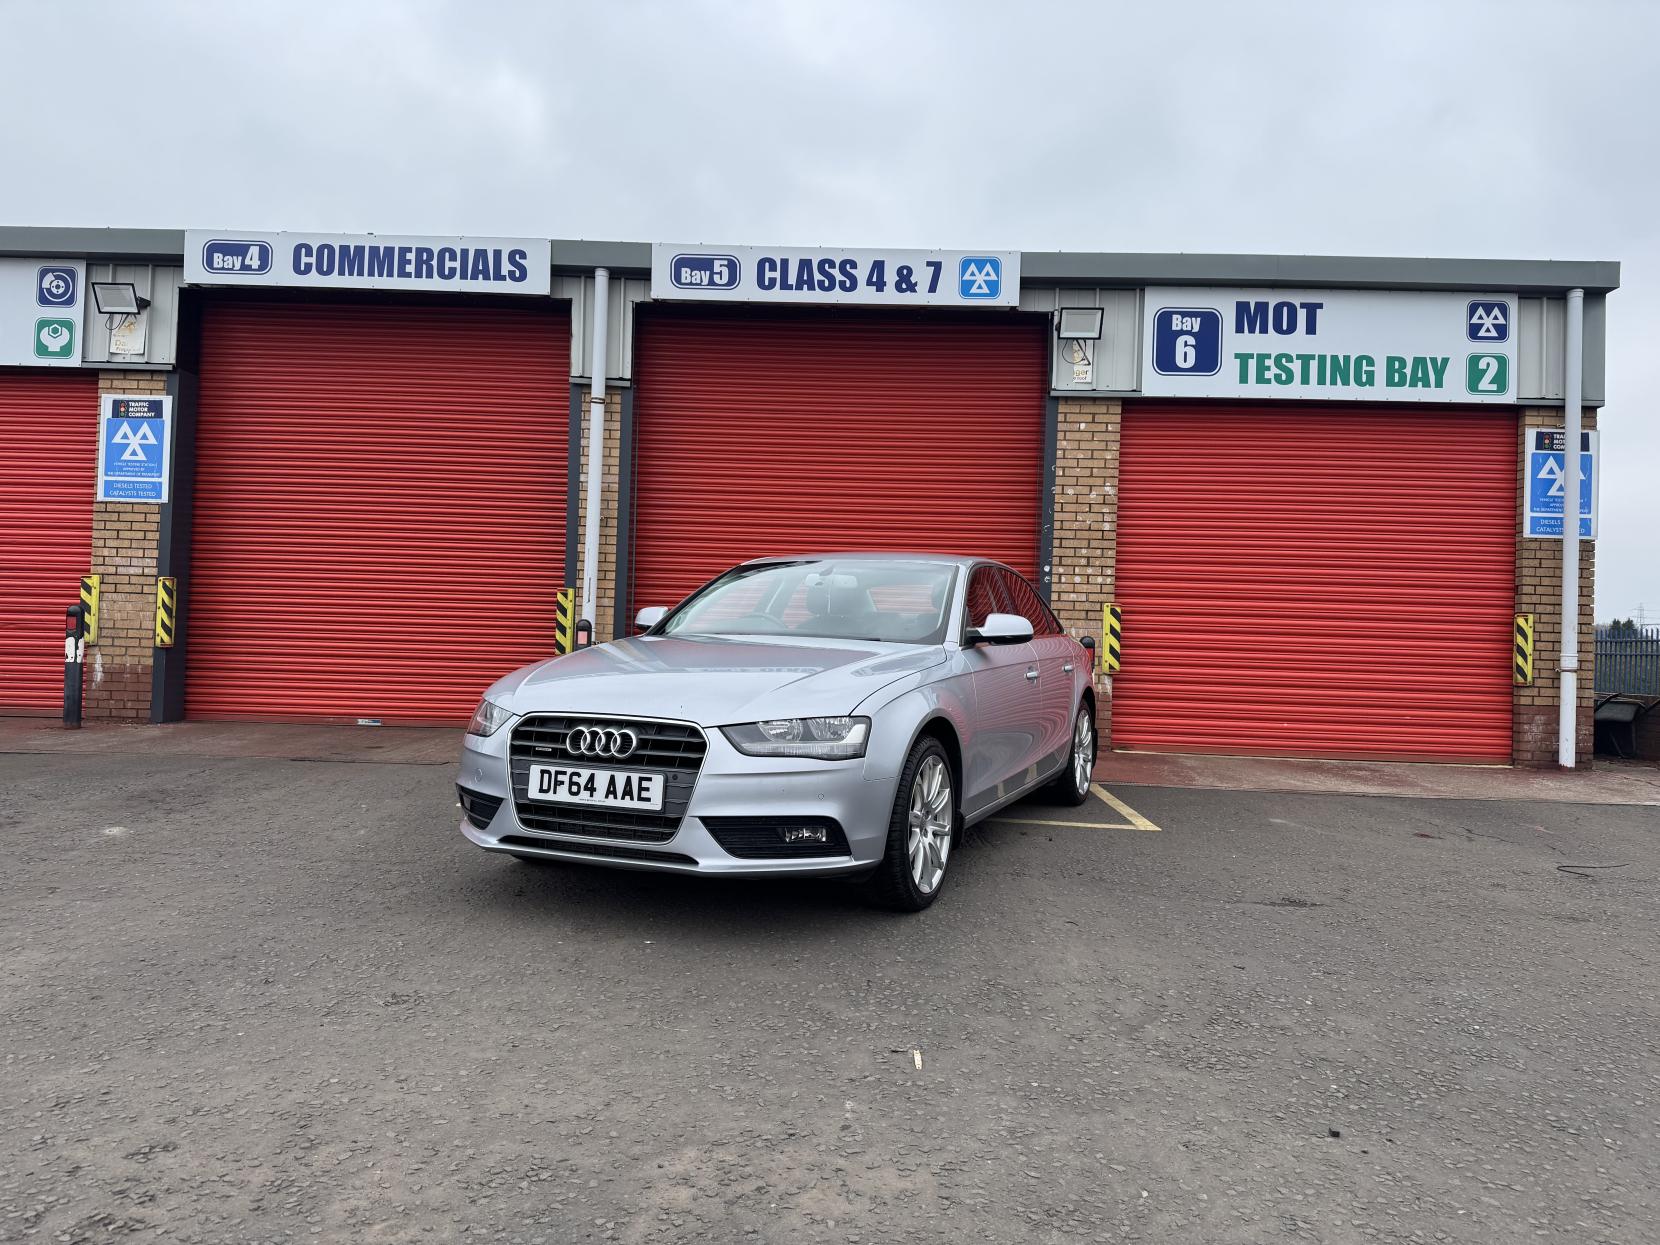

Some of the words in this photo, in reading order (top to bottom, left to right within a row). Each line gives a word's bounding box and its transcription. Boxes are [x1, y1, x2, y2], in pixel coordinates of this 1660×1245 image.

[213, 252, 243, 271] Bay
[244, 245, 261, 270] 4
[292, 242, 528, 282] COMMERCIALS
[680, 267, 711, 286] Bay
[713, 260, 729, 285] 5
[756, 257, 859, 293] CLASS
[865, 259, 887, 293] 4
[895, 265, 918, 294] &
[925, 260, 943, 294] 7
[1171, 314, 1201, 333] Bay
[1234, 300, 1324, 336] MOT
[1174, 334, 1196, 369] 6
[1233, 352, 1376, 388] TESTING
[1385, 355, 1451, 389] BAY
[1477, 356, 1498, 391] 2
[538, 768, 597, 798] DF64
[604, 774, 653, 803] AAE
